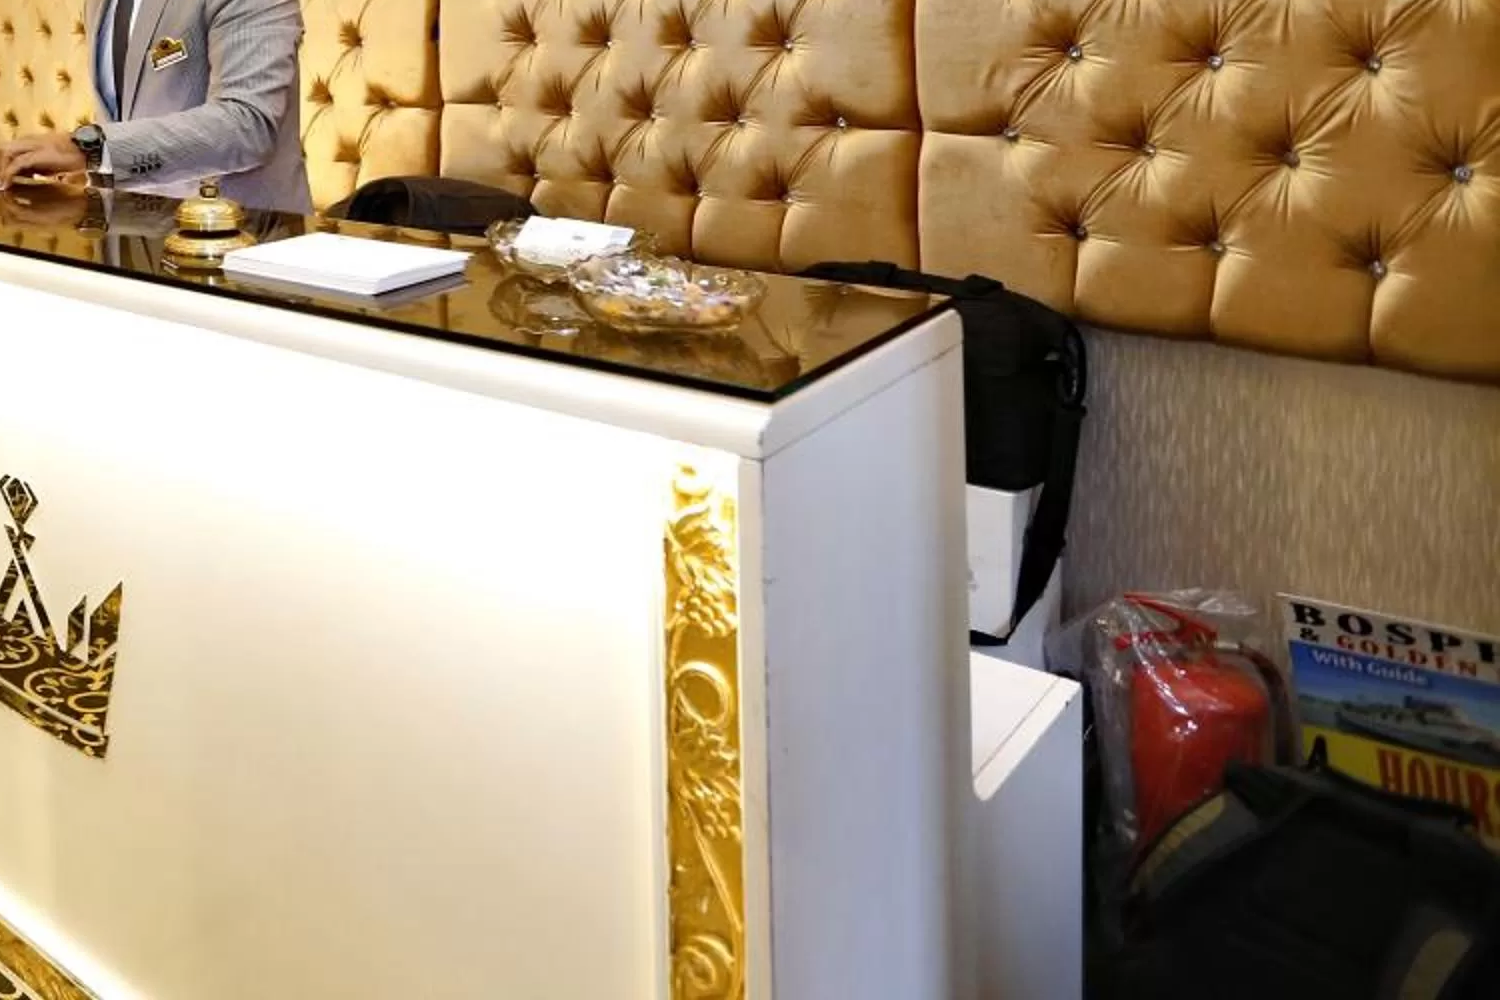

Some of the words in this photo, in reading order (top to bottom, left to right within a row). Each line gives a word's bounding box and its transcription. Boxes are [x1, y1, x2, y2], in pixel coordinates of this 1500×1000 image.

[1310, 648, 1363, 672] With
[1366, 662, 1428, 686] Guide
[1336, 634, 1477, 677] GOLDEN
[1377, 748, 1500, 837] HOUR
